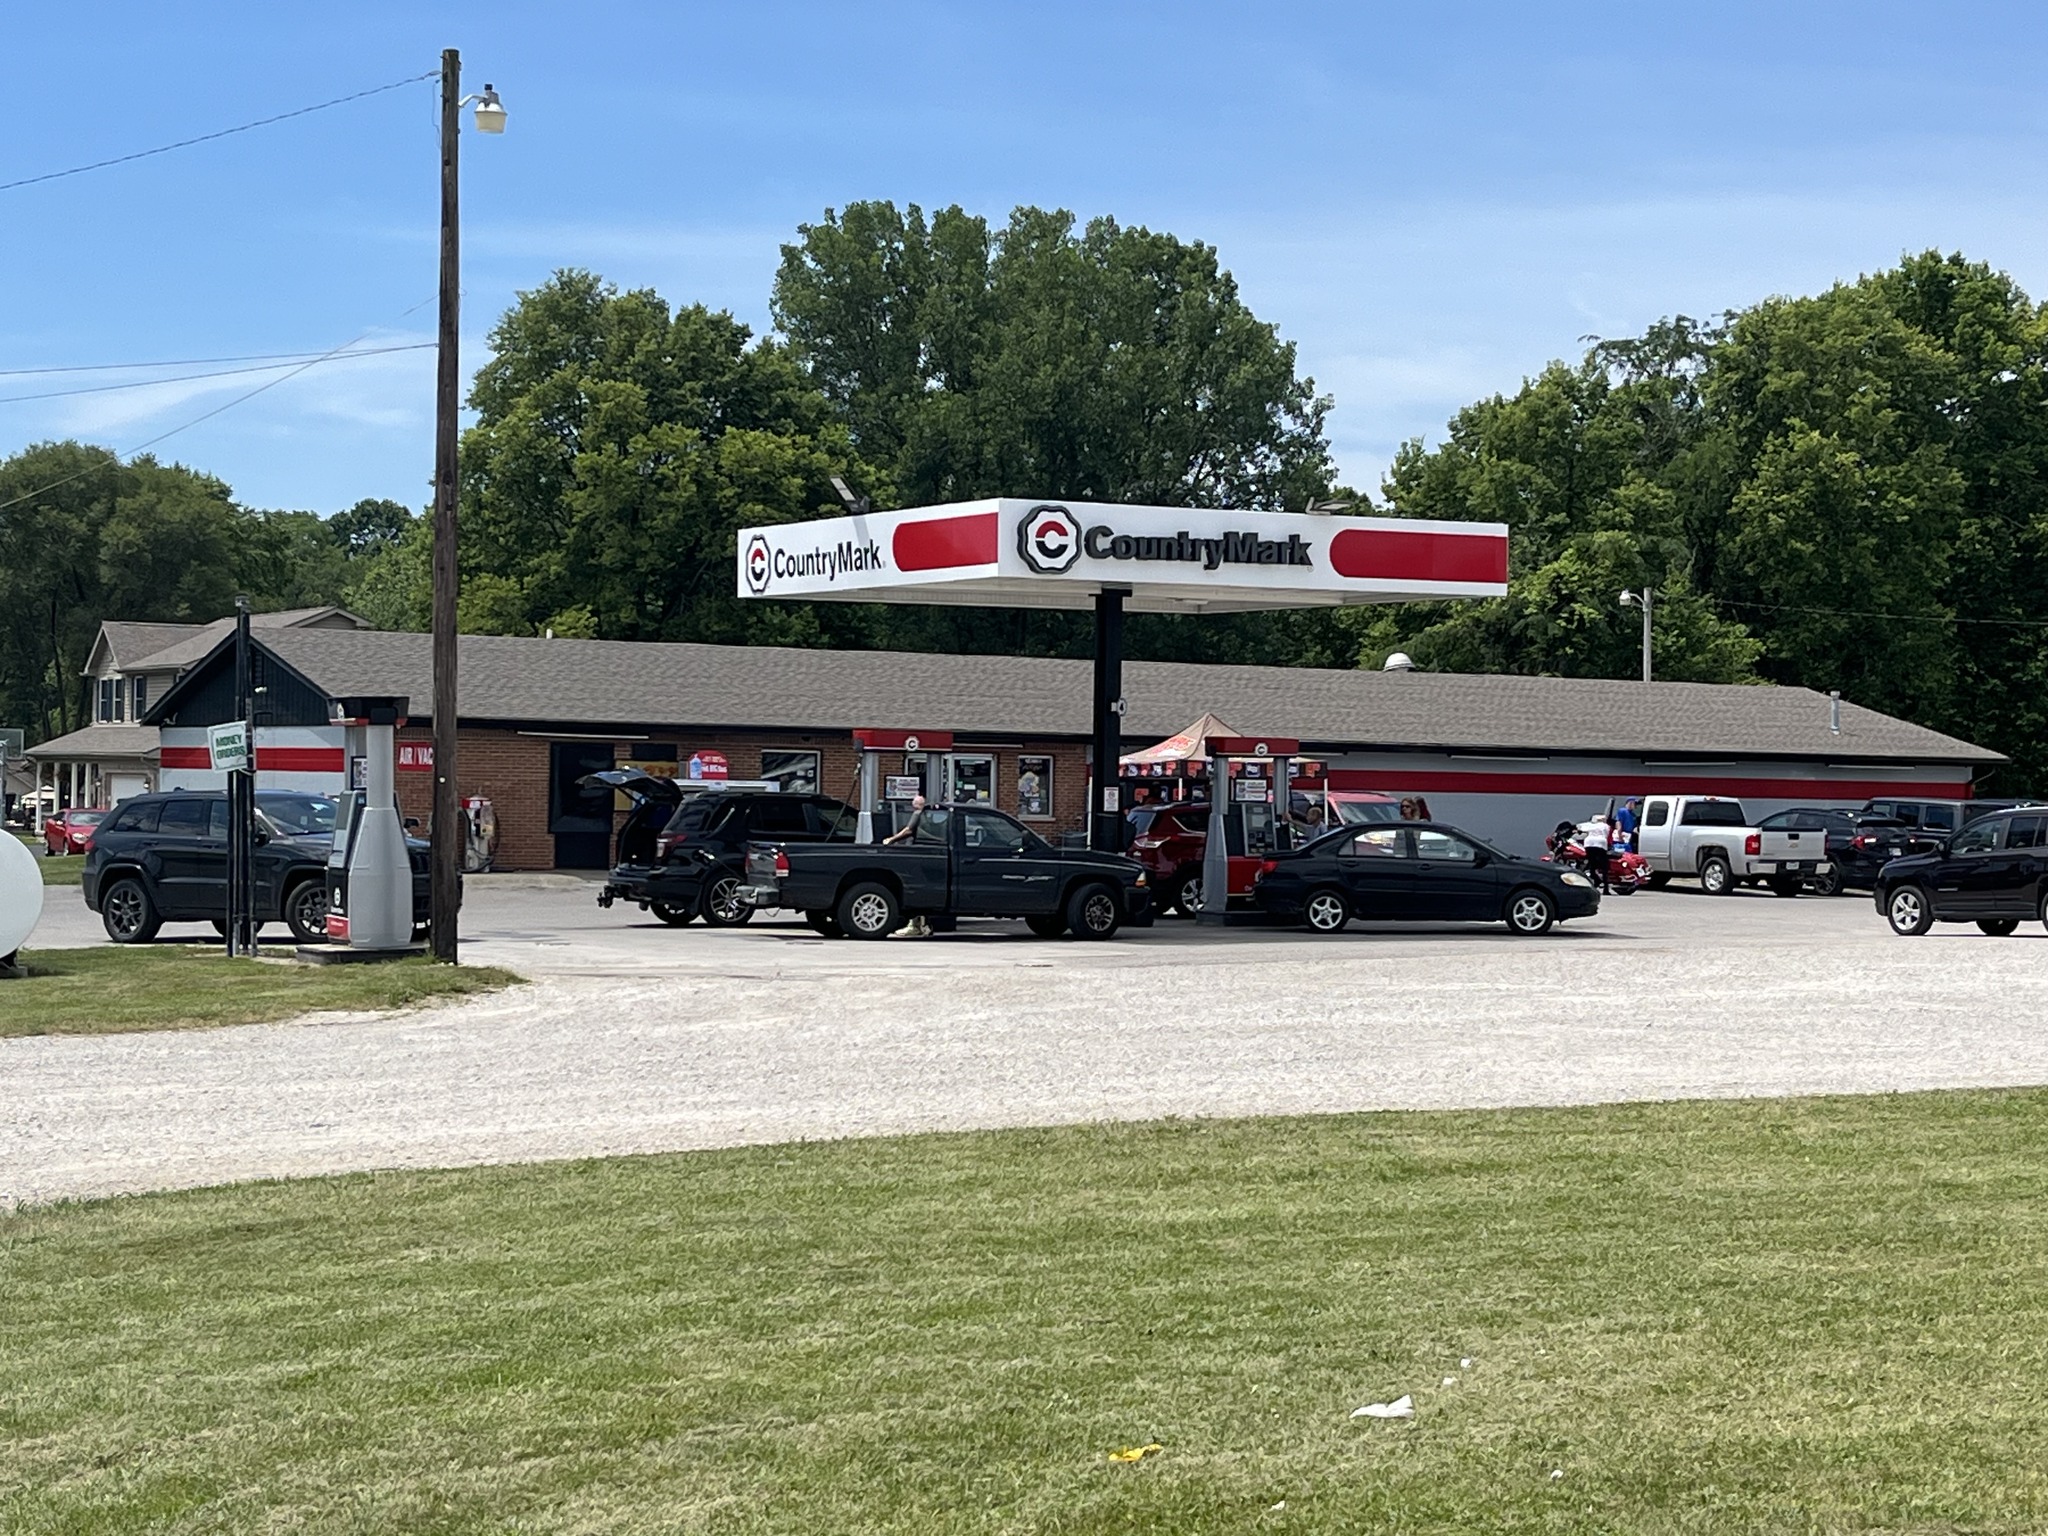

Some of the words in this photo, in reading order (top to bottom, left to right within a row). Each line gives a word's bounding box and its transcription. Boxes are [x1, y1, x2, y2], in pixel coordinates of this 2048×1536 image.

[774, 539, 881, 582] CountryMark
[1084, 525, 1313, 570] CountryMark
[399, 747, 413, 765] AIR
